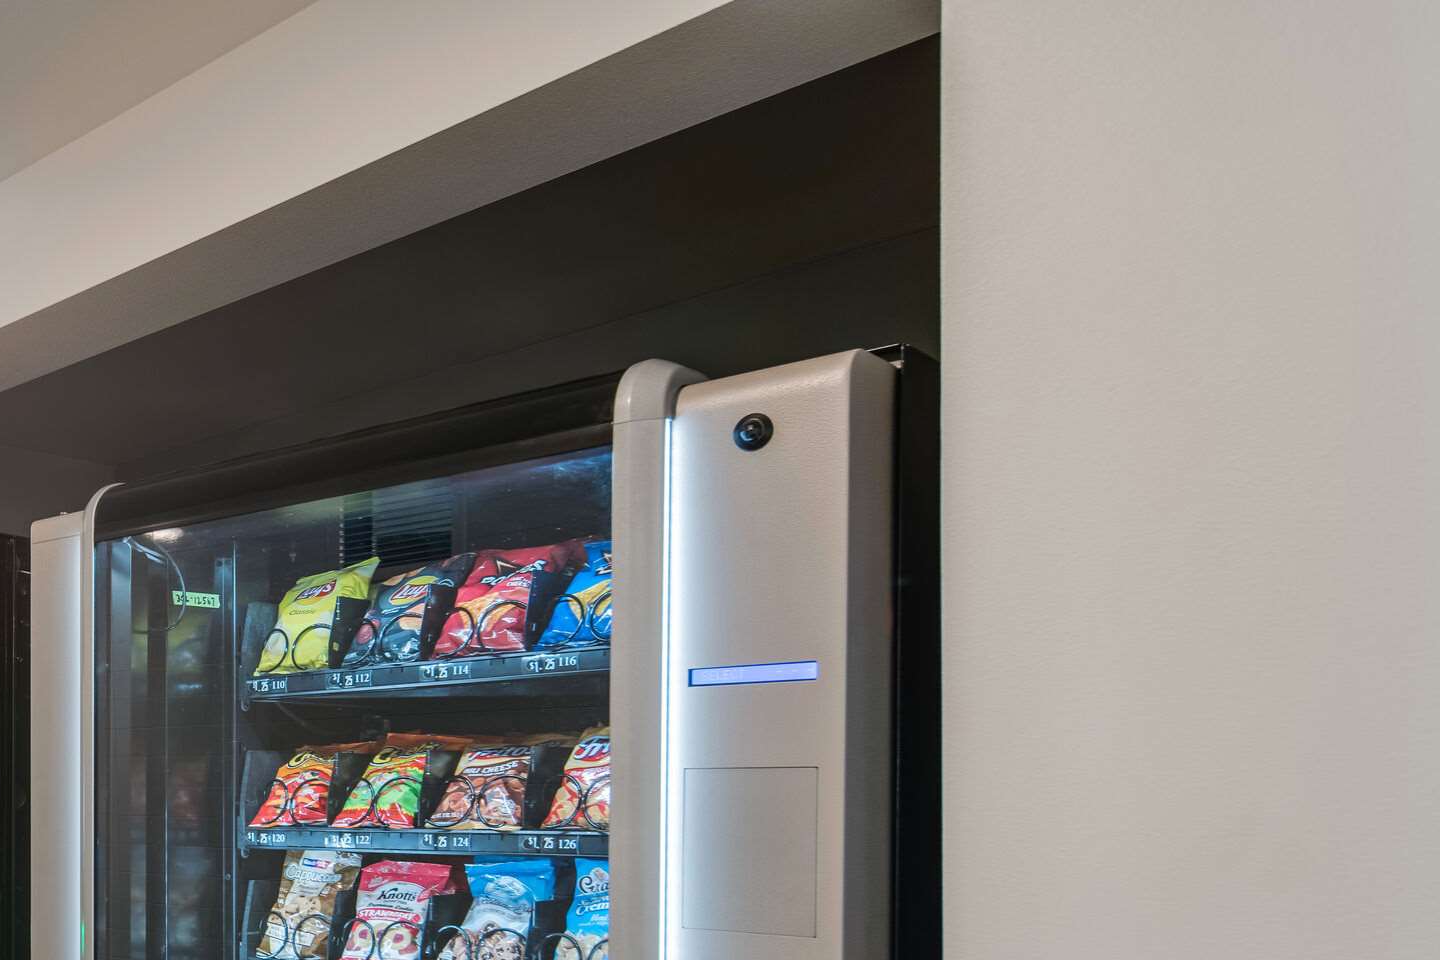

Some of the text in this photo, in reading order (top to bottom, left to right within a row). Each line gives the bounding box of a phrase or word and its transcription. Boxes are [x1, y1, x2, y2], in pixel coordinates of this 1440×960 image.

[558, 655, 577, 667] 116
[452, 664, 469, 676] 114
[355, 673, 370, 684] 112
[272, 680, 286, 690] 110
[272, 833, 286, 843] 120
[452, 837, 469, 847] 124
[558, 838, 577, 849] 126
